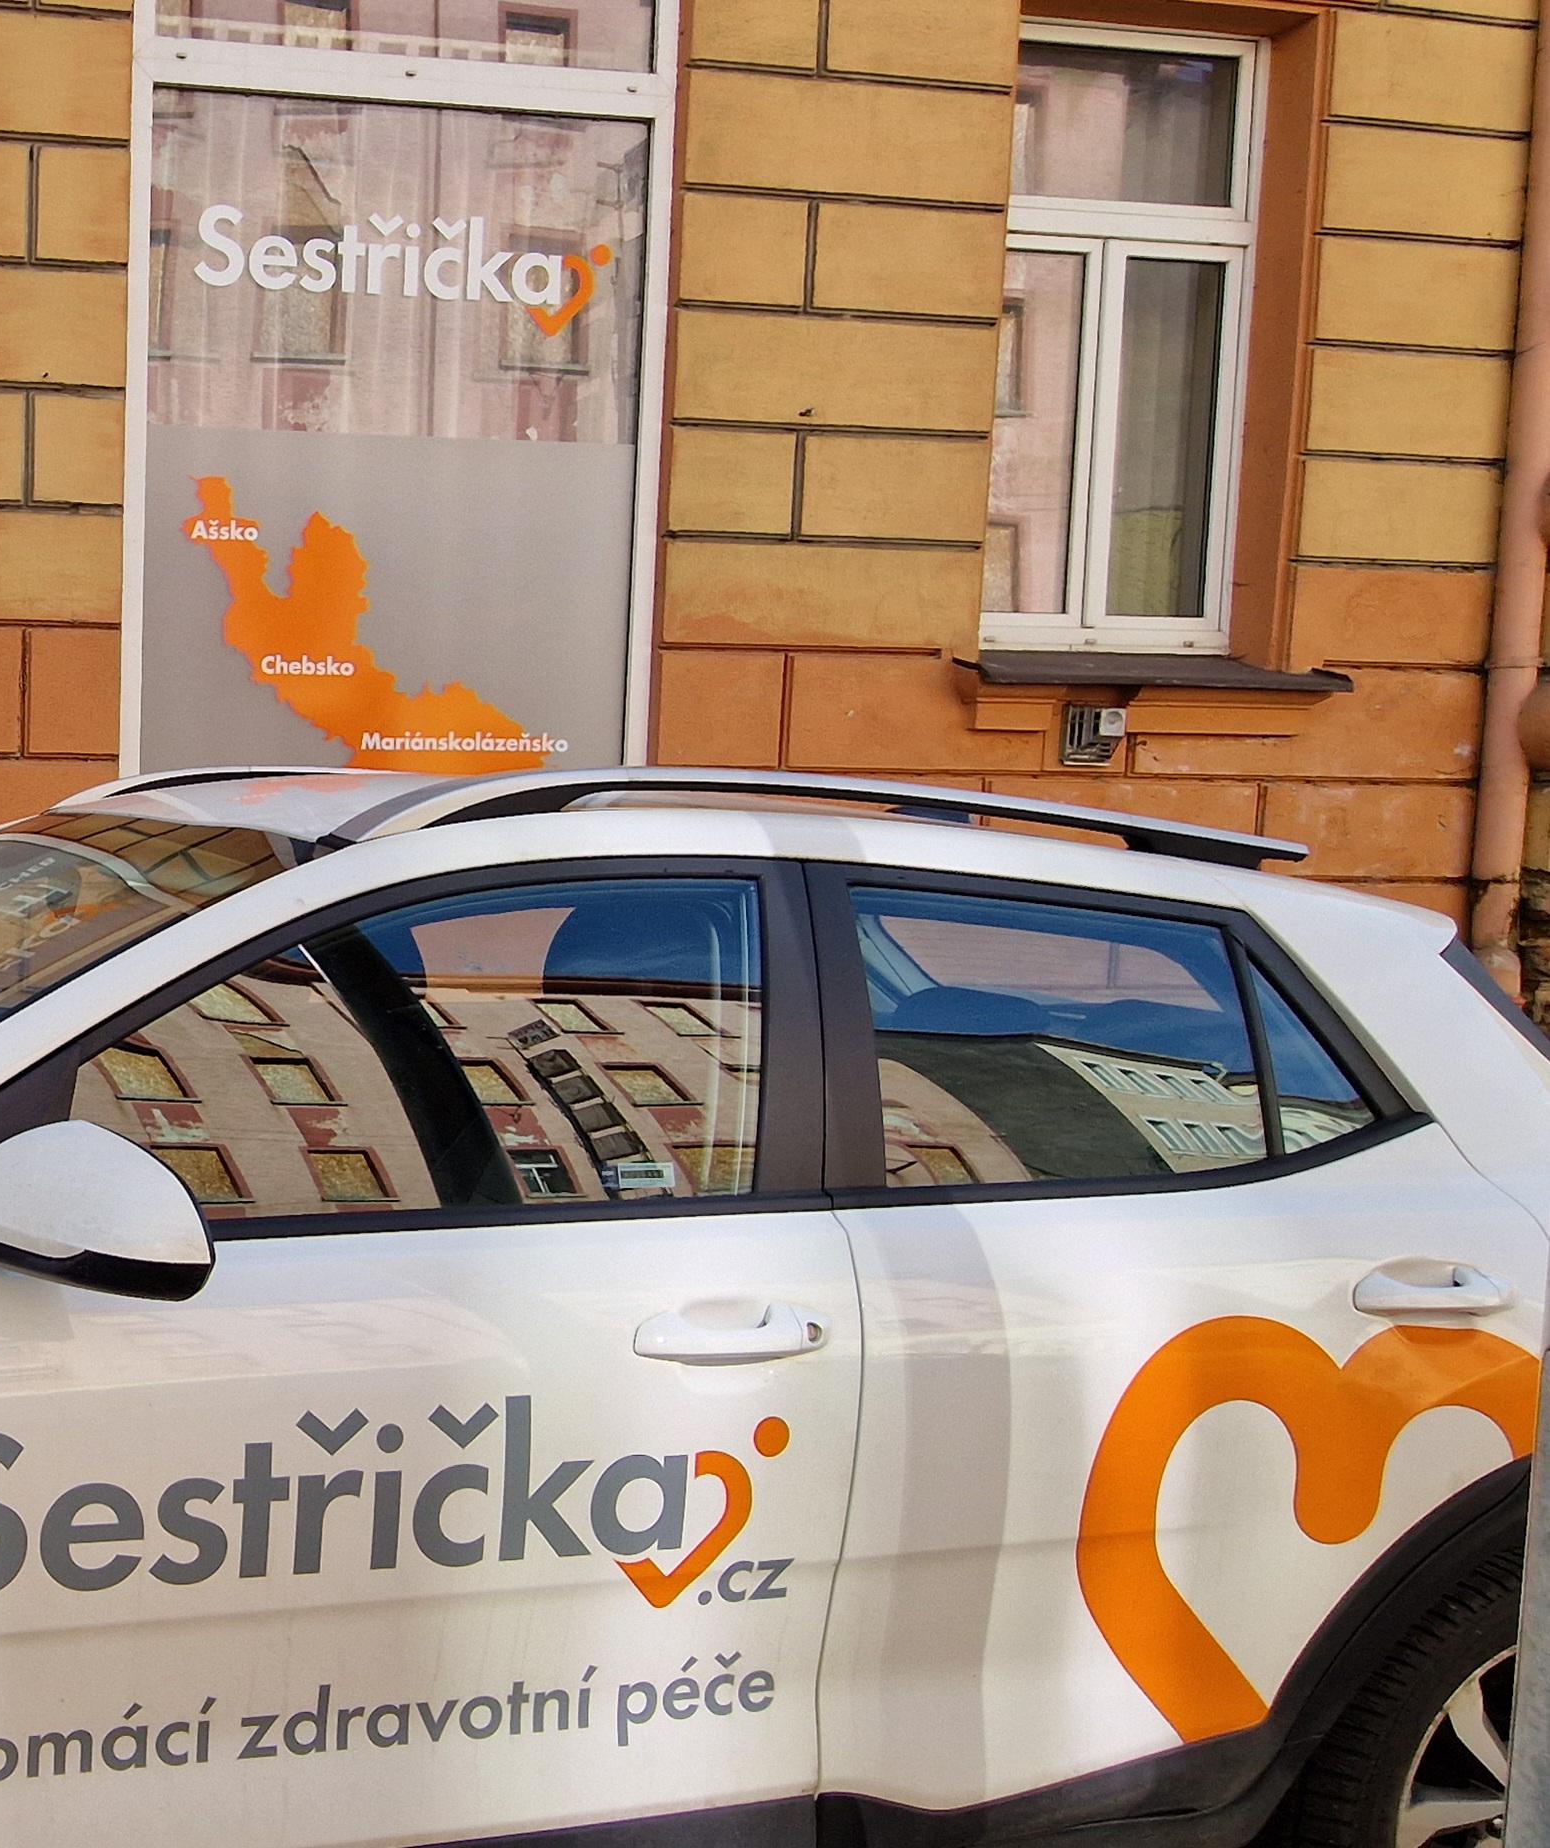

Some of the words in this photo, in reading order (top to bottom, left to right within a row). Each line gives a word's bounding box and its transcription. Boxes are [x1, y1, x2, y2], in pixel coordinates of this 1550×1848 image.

[194, 205, 564, 304] Sestřička
[190, 518, 259, 542] Ašsko
[261, 654, 355, 677] Chebsko
[361, 729, 569, 755] Mariánskolázeňsko
[238, 1665, 594, 1758] zdravotní
[614, 1651, 777, 1747] péče
